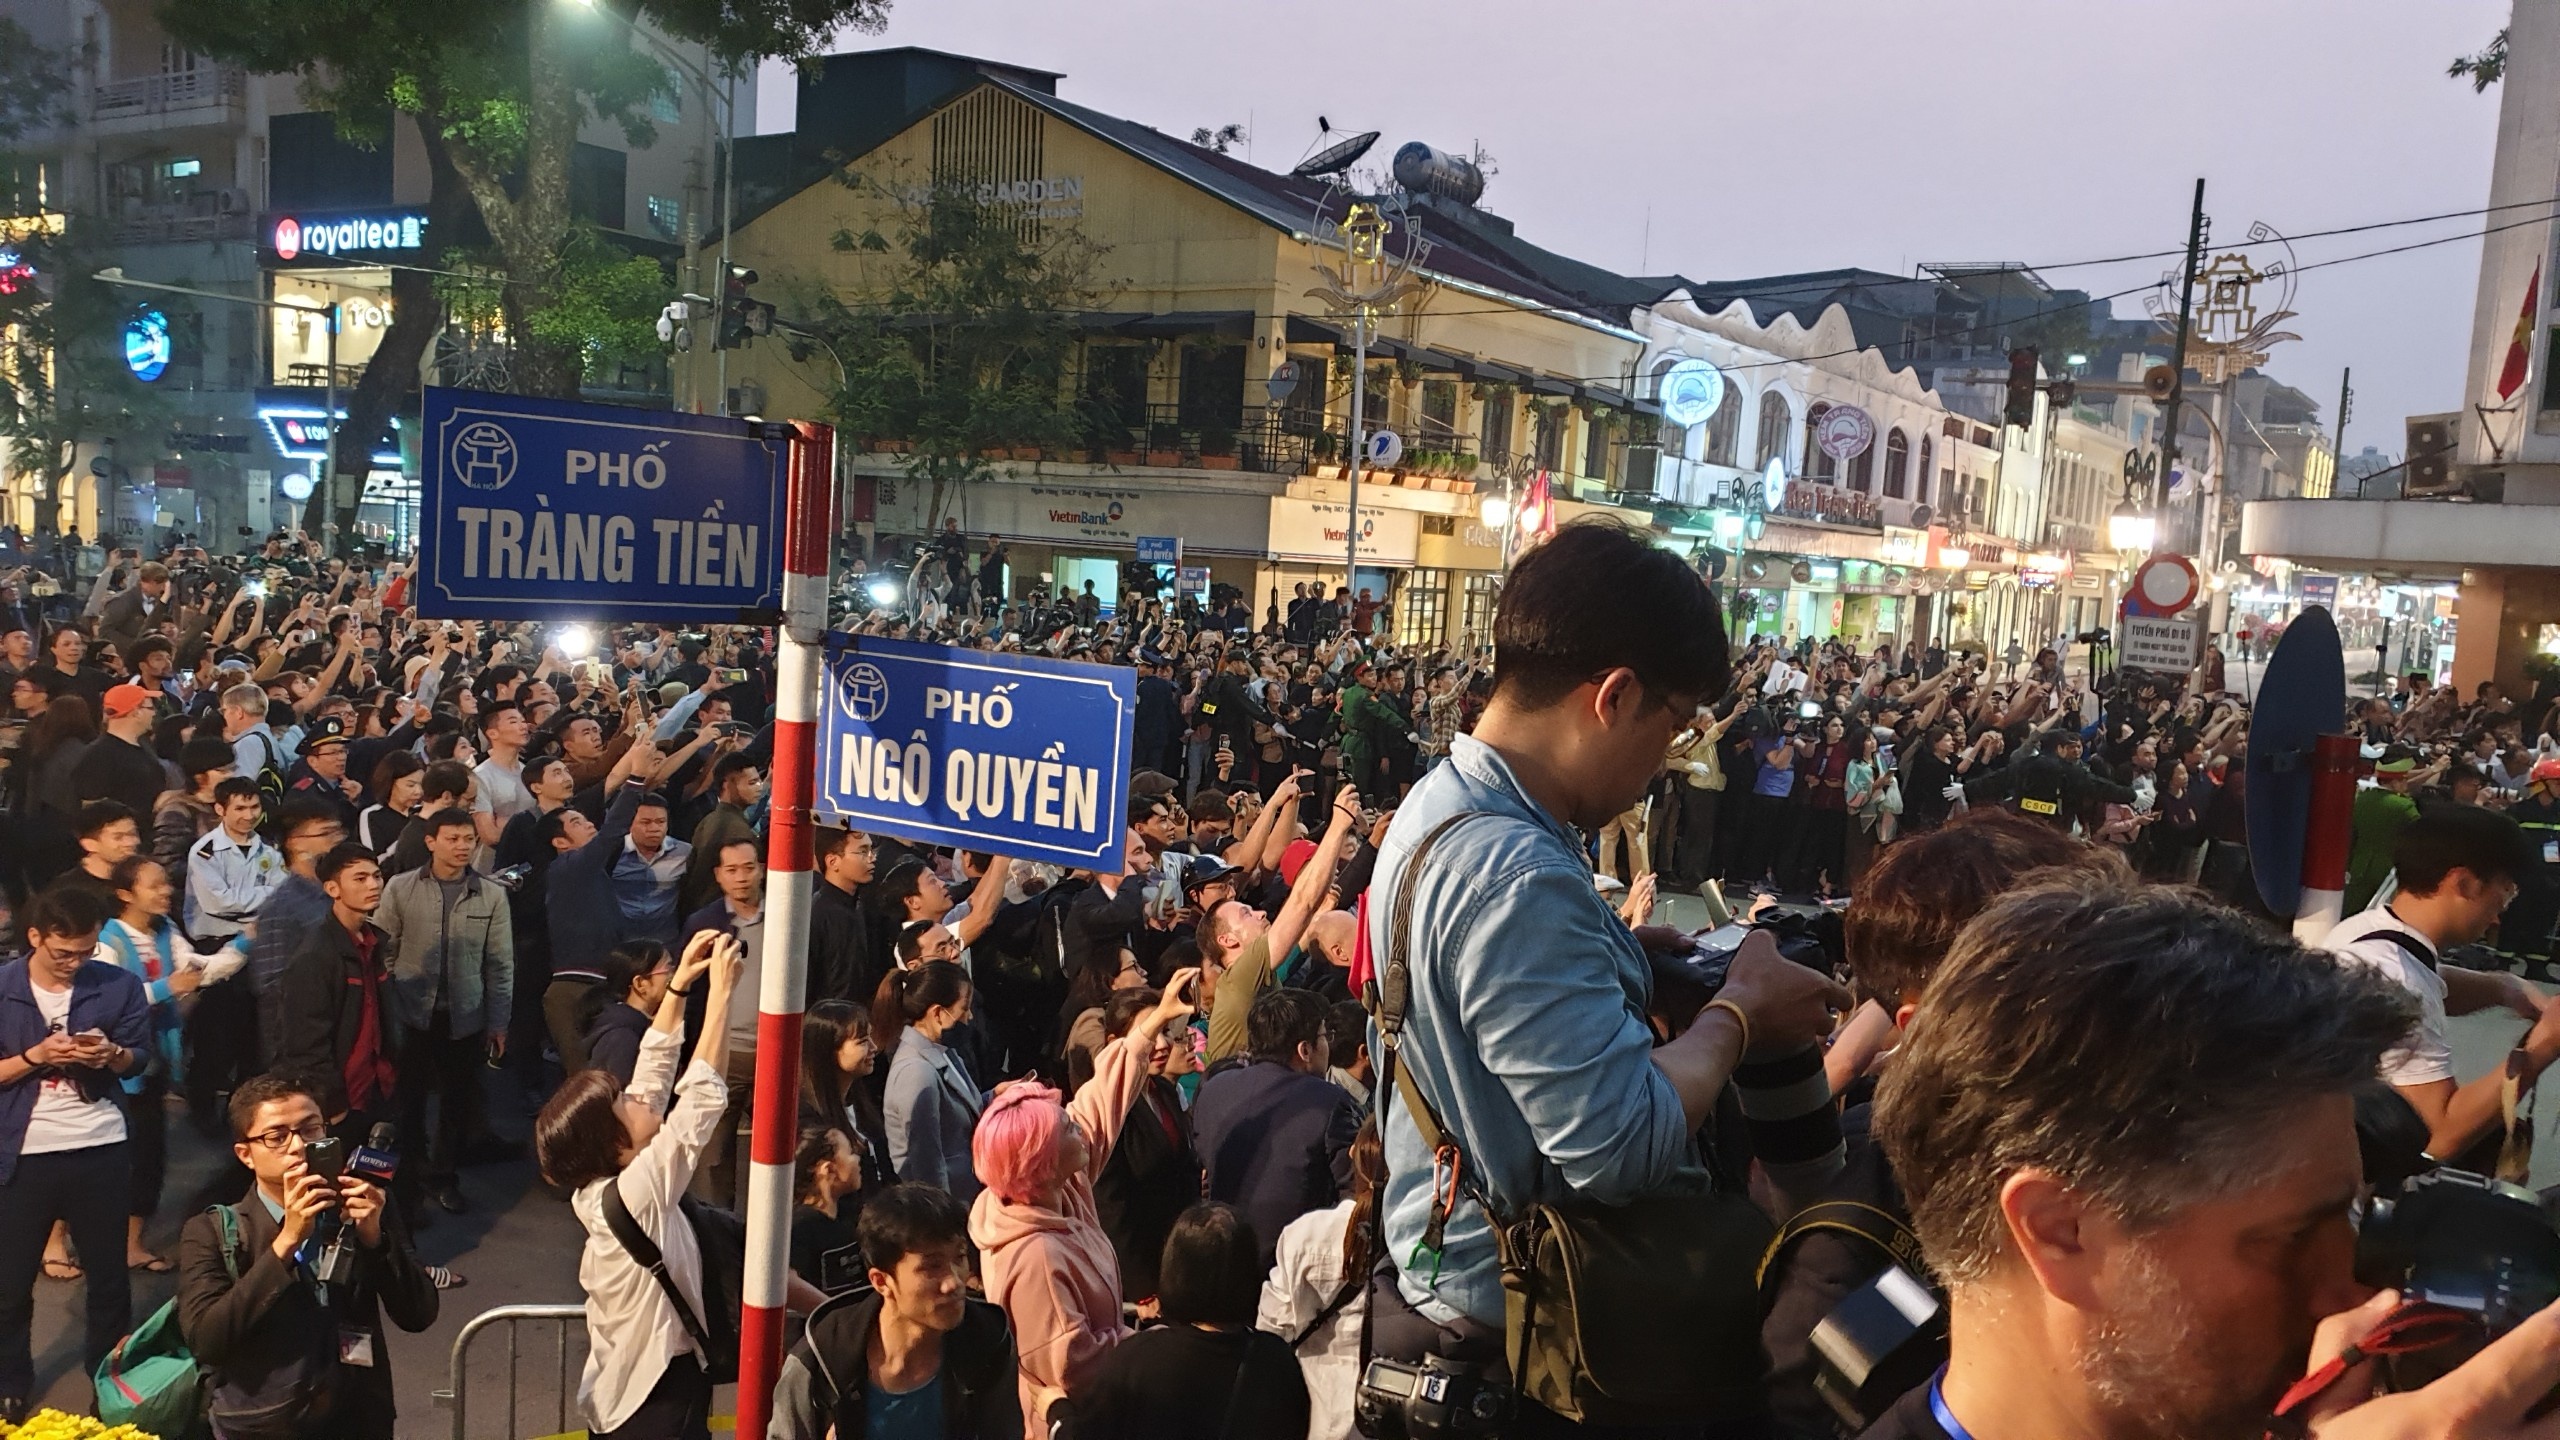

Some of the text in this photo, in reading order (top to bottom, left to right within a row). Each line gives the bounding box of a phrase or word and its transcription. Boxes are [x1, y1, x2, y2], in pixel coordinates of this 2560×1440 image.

[977, 177, 1083, 207] GARDEN
[303, 218, 399, 256] royaltea
[566, 441, 670, 489] PHỐ
[1049, 509, 1109, 526] VietinBank
[458, 494, 759, 589] TRÀNG TIỀN
[925, 683, 1020, 728] PHỐ
[840, 729, 1099, 834] NGÔ QUYỀN
[360, 1154, 388, 1168] KOMPAS
